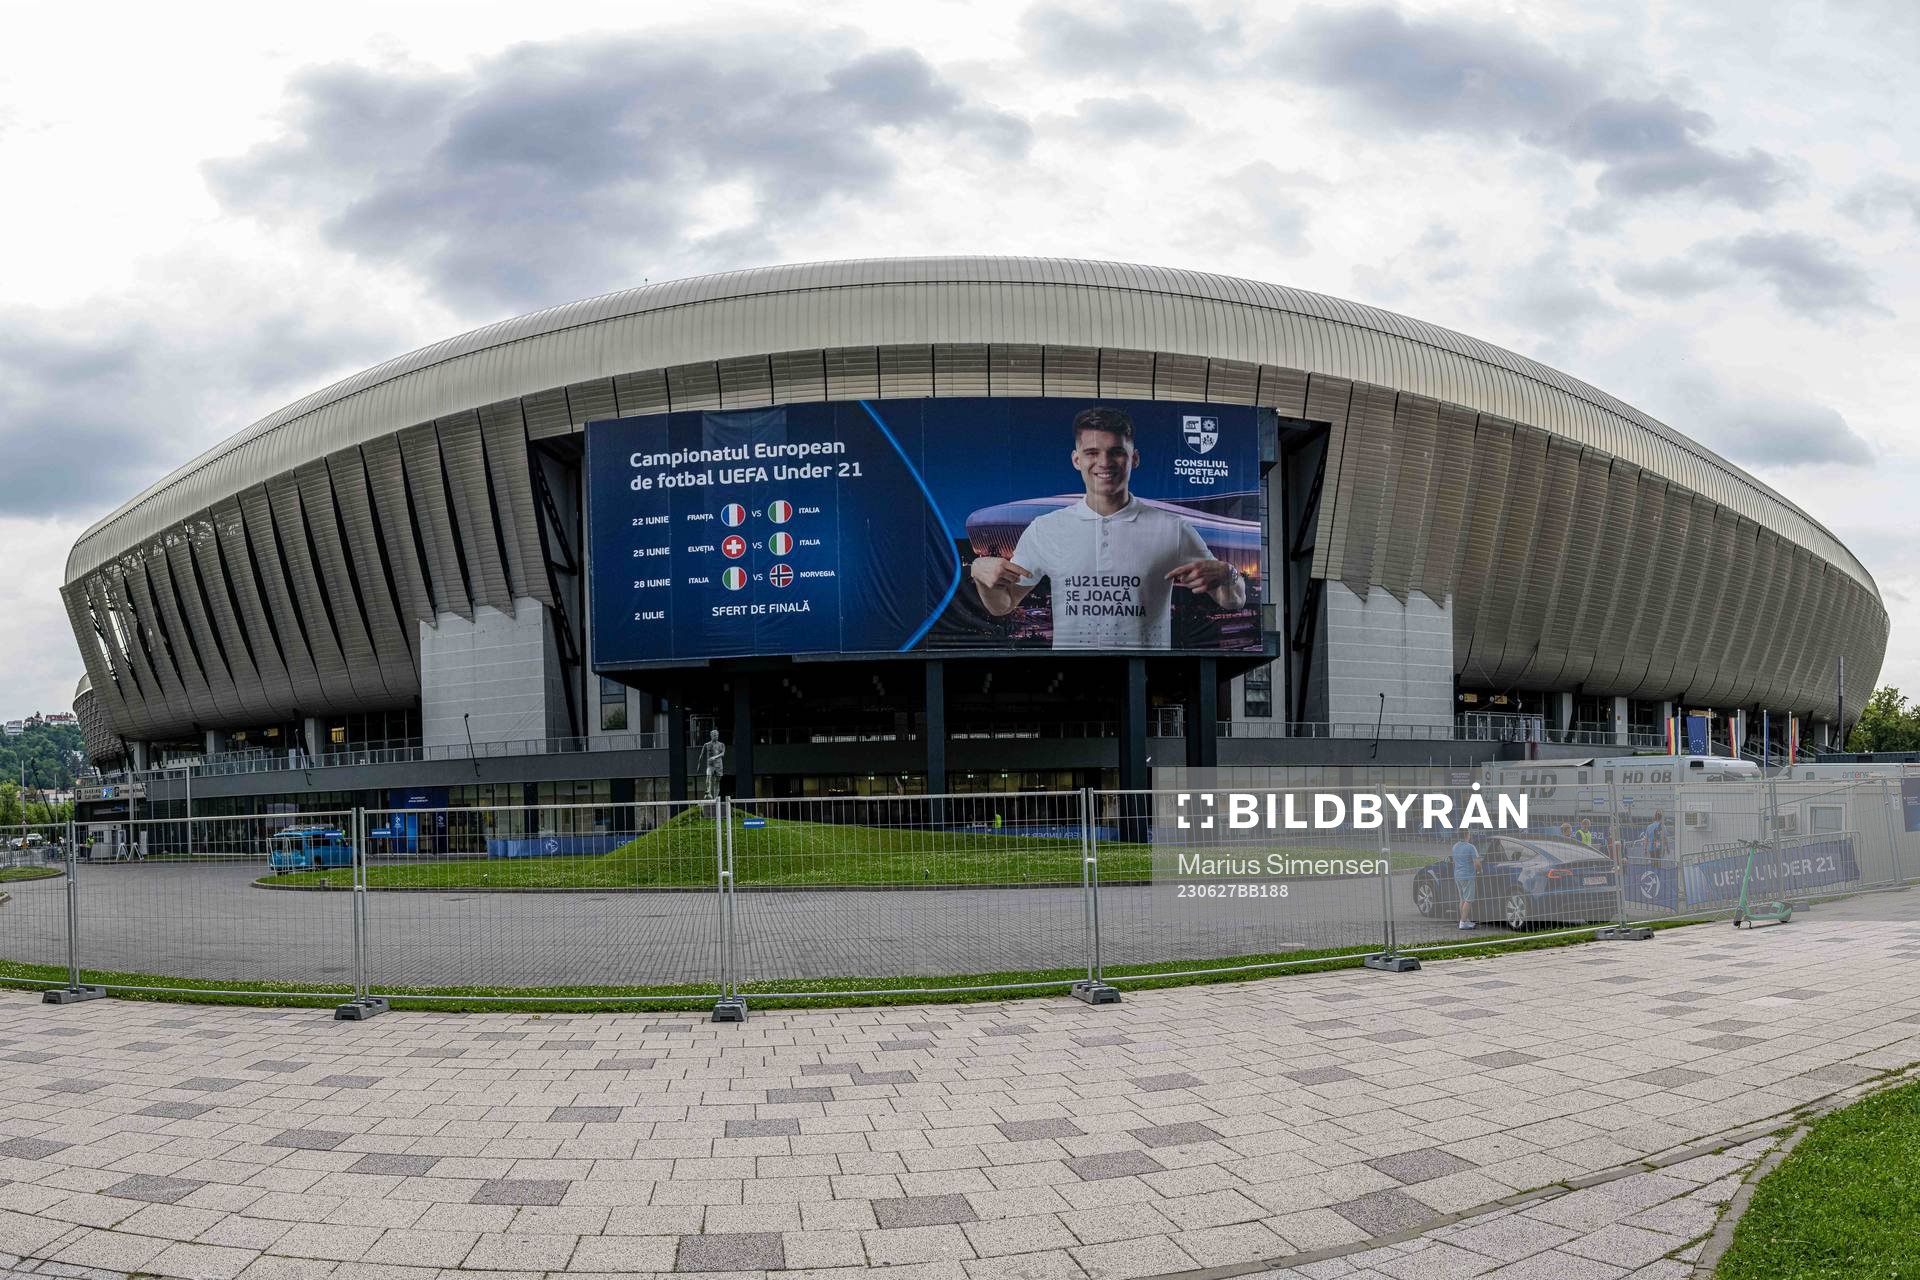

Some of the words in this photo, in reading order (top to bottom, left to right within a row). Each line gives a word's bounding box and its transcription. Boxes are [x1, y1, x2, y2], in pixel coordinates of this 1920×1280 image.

[630, 444, 750, 468] Campionatul
[754, 441, 845, 459] European
[1174, 459, 1228, 469] CONSILIUL
[630, 476, 653, 491] de
[657, 468, 714, 488] fotbal
[719, 467, 769, 485] UEFA
[773, 463, 833, 480] Under
[838, 462, 863, 477] 21
[1174, 467, 1229, 477] JUDEȚEAN
[1189, 476, 1215, 485] CLUJ
[632, 518, 644, 526] 22
[645, 515, 670, 525] IUNIE
[687, 513, 714, 522] FRANȚA
[633, 549, 645, 557] 25
[646, 547, 670, 556] IUNIE
[800, 570, 836, 578] NORVEGIA
[633, 580, 645, 589] 28
[647, 578, 671, 588] IUNIE
[1065, 575, 1141, 588] #U21EURO
[1066, 590, 1080, 602] SE
[1083, 587, 1132, 602] JOACĂ
[712, 605, 748, 617] SFERT
[750, 604, 766, 615] DE
[769, 600, 811, 613] FINALĂ
[1065, 601, 1078, 616] ÎN
[1082, 601, 1147, 617] ROMÂNIA
[634, 612, 641, 621] 2
[642, 610, 665, 620] IULIE
[1622, 770, 1644, 784] HD
[1815, 855, 1836, 873] 21
